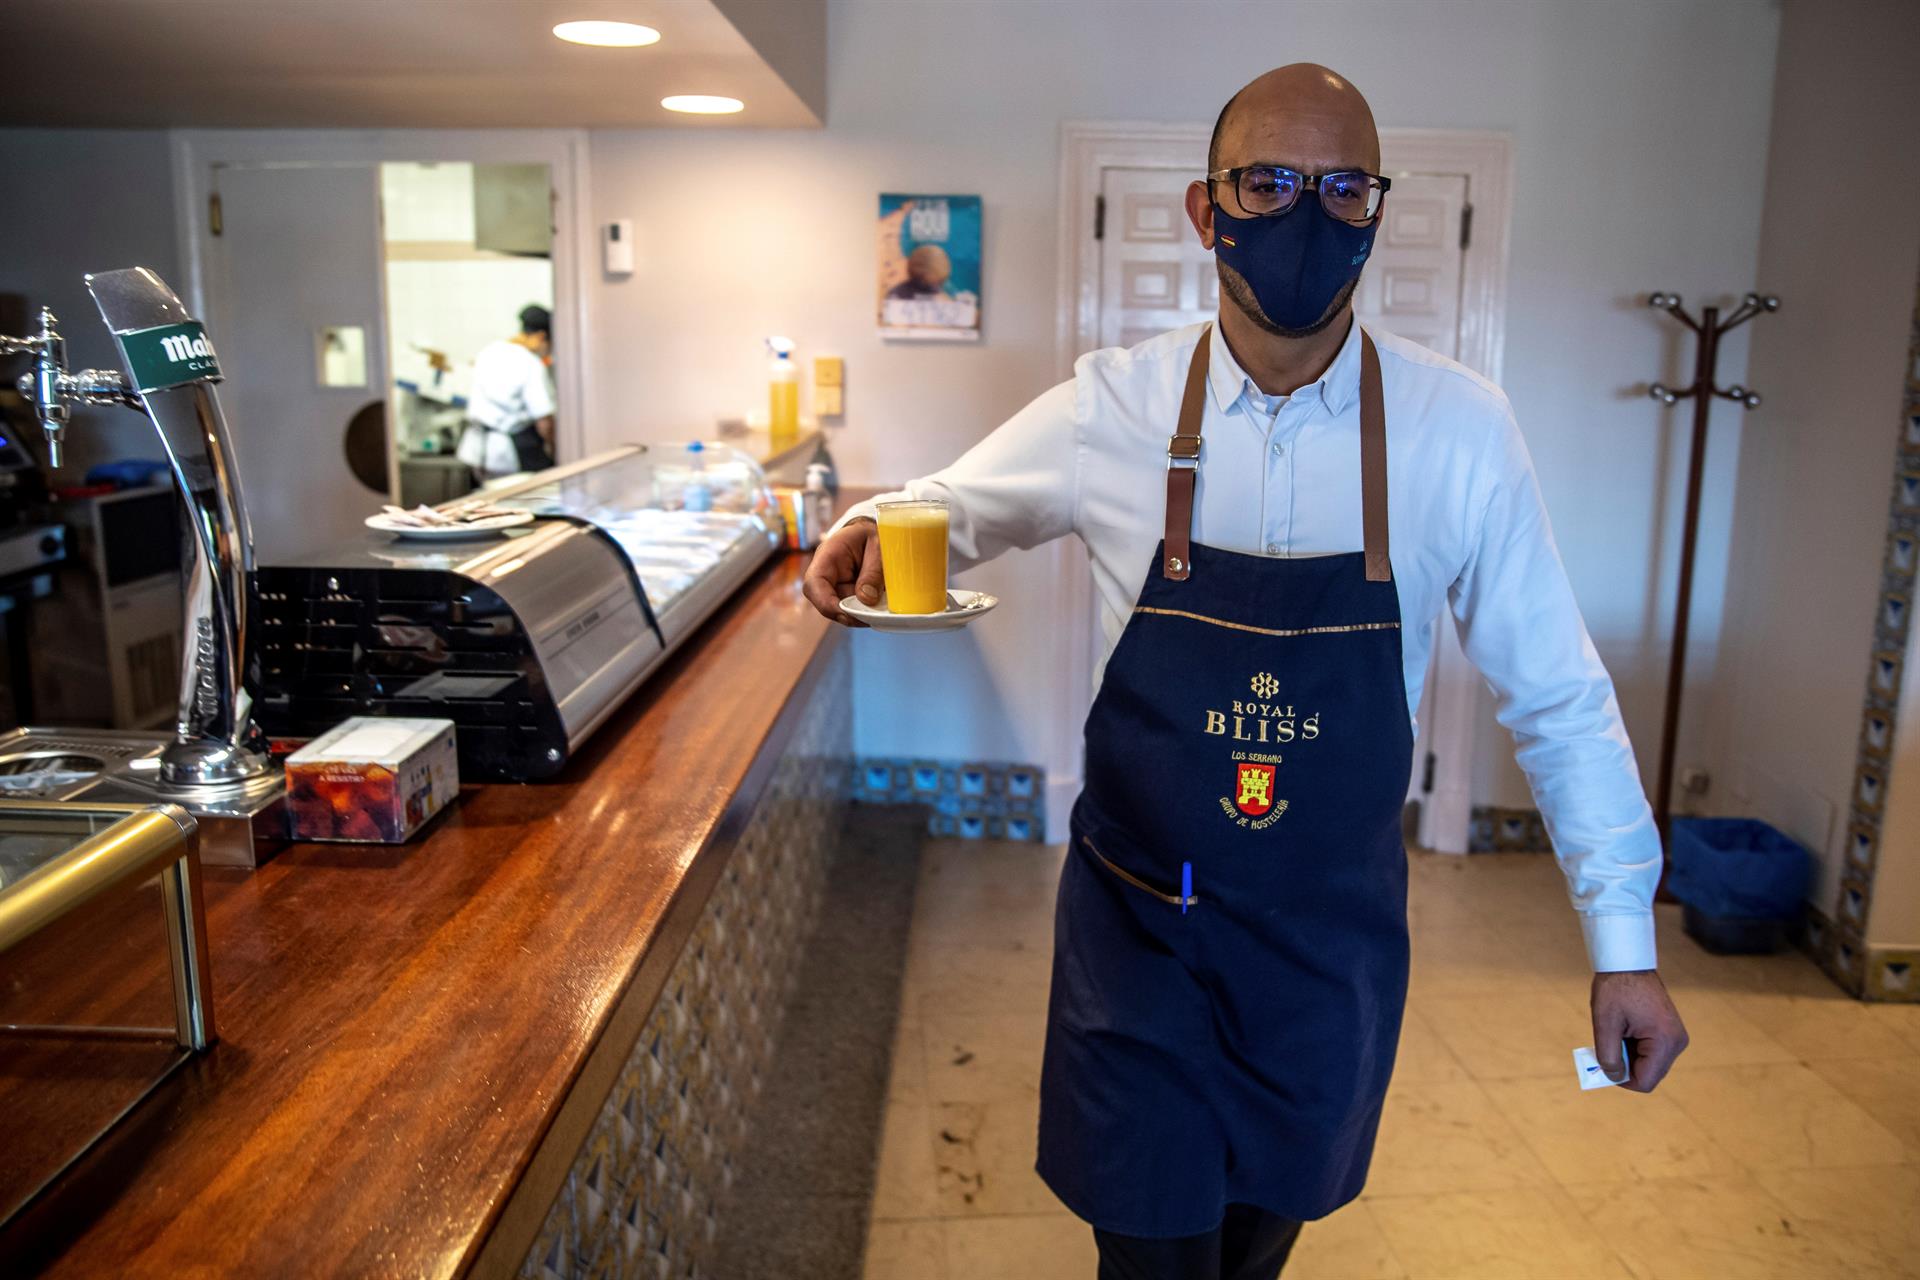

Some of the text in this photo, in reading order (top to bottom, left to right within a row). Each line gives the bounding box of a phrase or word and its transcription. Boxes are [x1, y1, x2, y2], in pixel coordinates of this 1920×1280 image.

[1231, 700, 1296, 717] ROYAL
[1204, 709, 1320, 743] BLISS
[1231, 750, 1282, 763] LOS SERRANO
[1219, 797, 1238, 819] GRUPO
[1236, 816, 1249, 828] DE
